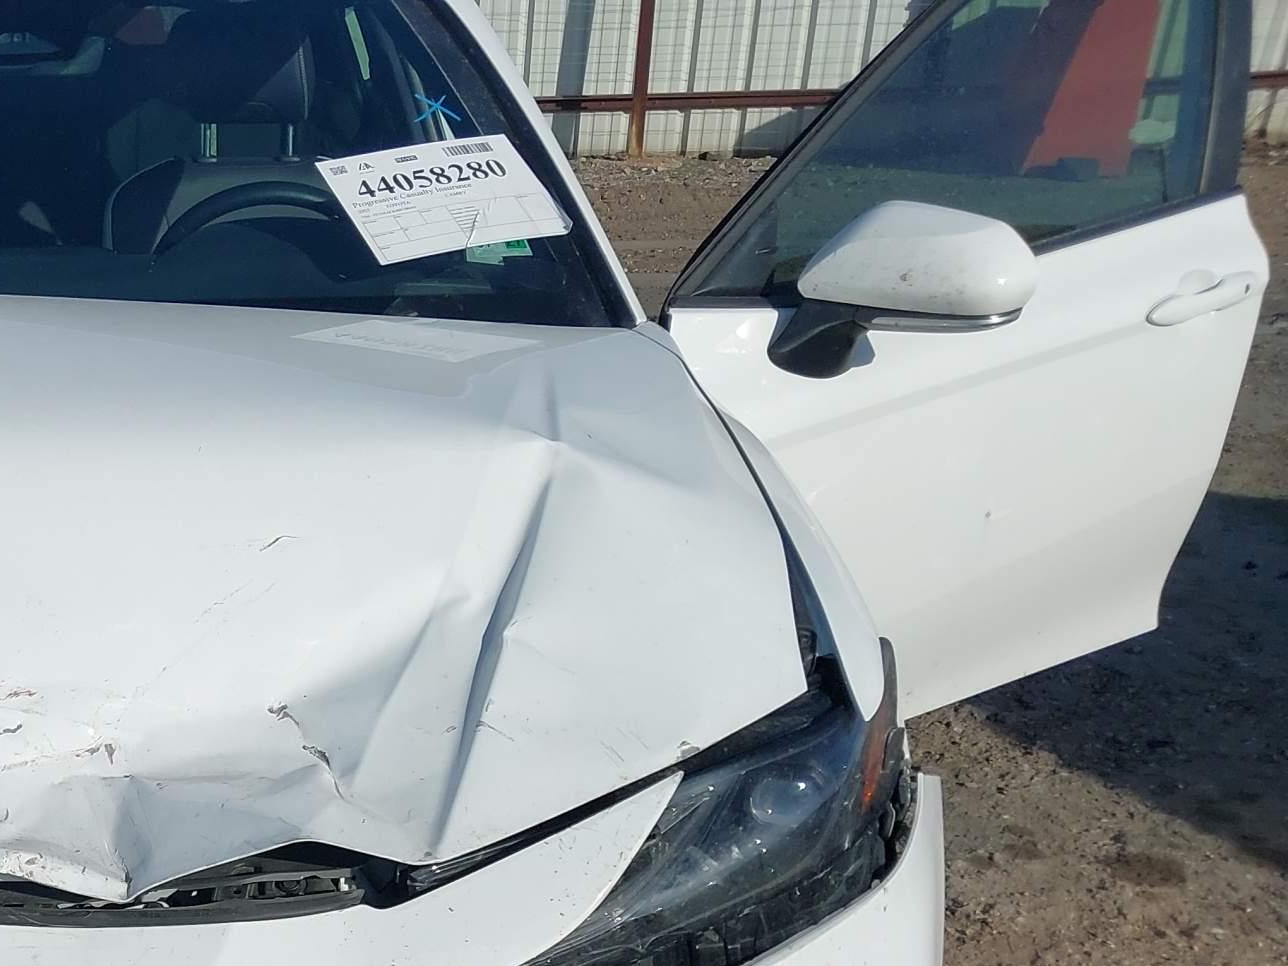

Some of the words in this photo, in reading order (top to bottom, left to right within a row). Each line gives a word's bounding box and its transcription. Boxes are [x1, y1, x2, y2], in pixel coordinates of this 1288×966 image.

[358, 159, 507, 198] 44058280
[352, 195, 398, 209] Progressive
[399, 187, 433, 200] Casualty
[433, 183, 473, 194] Insurance
